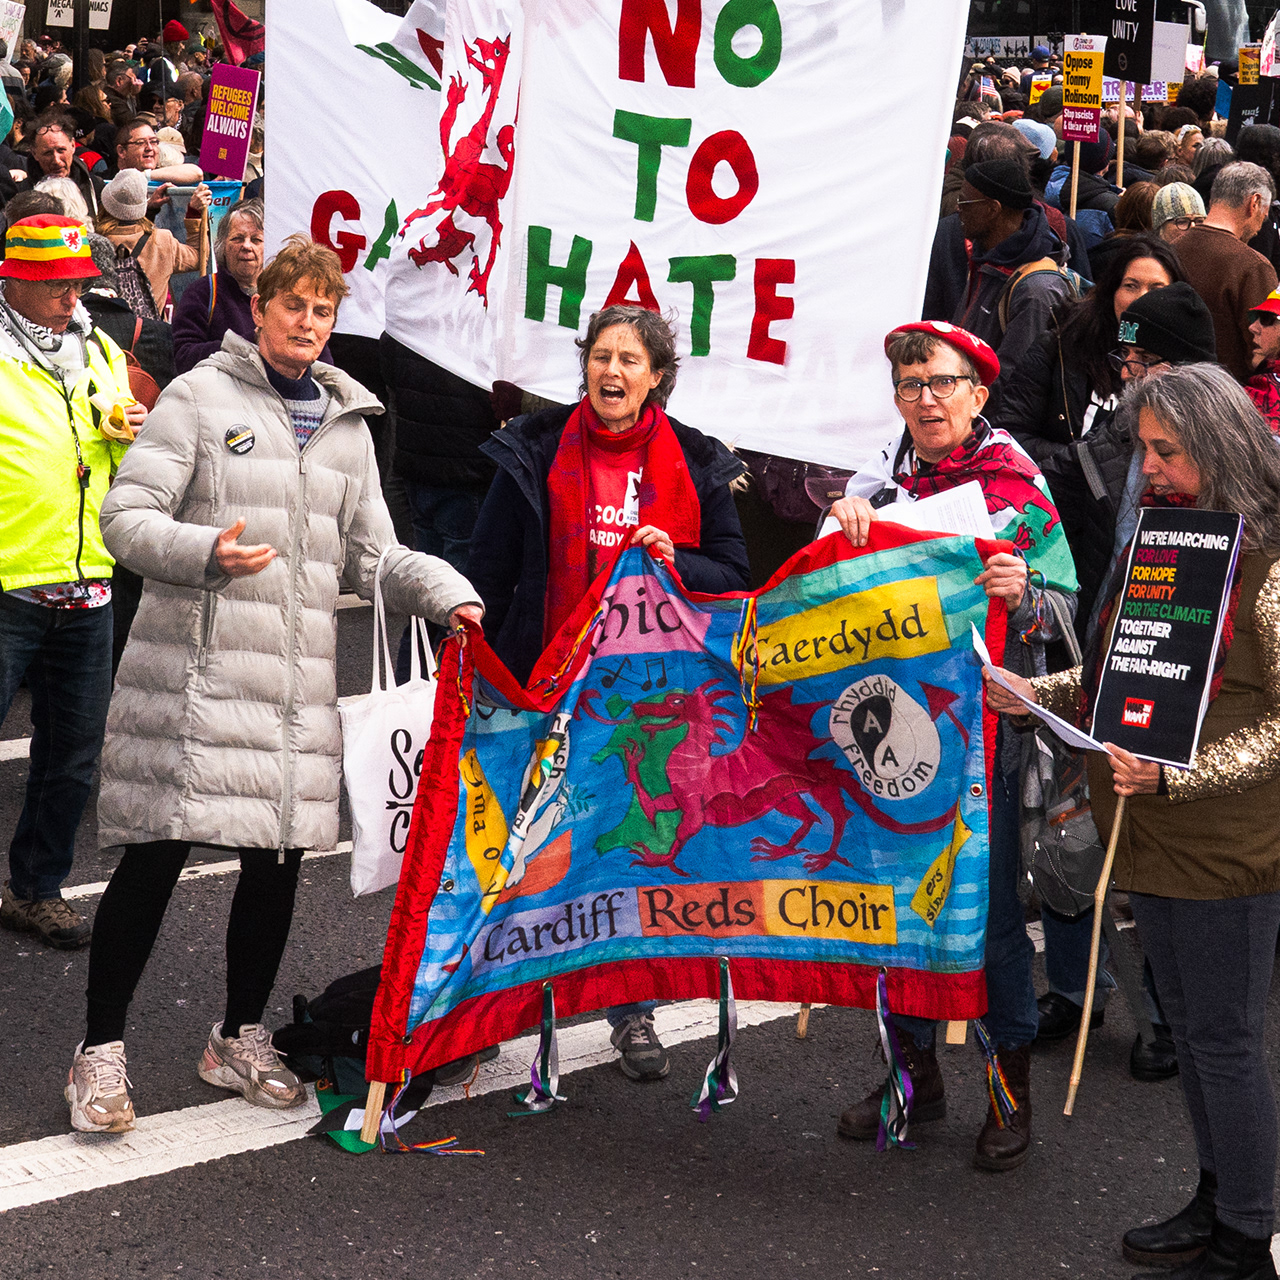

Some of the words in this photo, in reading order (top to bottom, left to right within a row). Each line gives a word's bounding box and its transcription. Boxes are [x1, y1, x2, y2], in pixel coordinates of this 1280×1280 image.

[1111, 18, 1140, 43] UNITY
[211, 84, 253, 106] REFUGEES
[209, 99, 251, 122] WELCOME
[206, 113, 248, 140] ALWAYS
[612, 108, 760, 226] TO
[524, 224, 796, 366] HATE
[1167, 532, 1230, 551] MARCHING
[1135, 548, 1155, 563] FOR
[1154, 549, 1179, 564] LOVE
[1131, 565, 1151, 581] FOR
[1150, 567, 1177, 583] HOPE
[1127, 583, 1147, 599] FOR
[1146, 585, 1177, 601] UNITY
[1123, 601, 1143, 617] FOR
[1160, 603, 1213, 625] CLIMATE
[744, 603, 929, 672] Caerdydd
[1119, 619, 1172, 639] TOGETHER
[1114, 637, 1157, 656] AGAINST
[1110, 655, 1130, 672] THE
[831, 676, 897, 725] rhyddid
[863, 708, 884, 734] A
[1123, 709, 1150, 726] WANT
[881, 745, 900, 768] A
[483, 890, 625, 963] Cardiff
[642, 887, 757, 929] Reds
[778, 884, 891, 931] Choir
